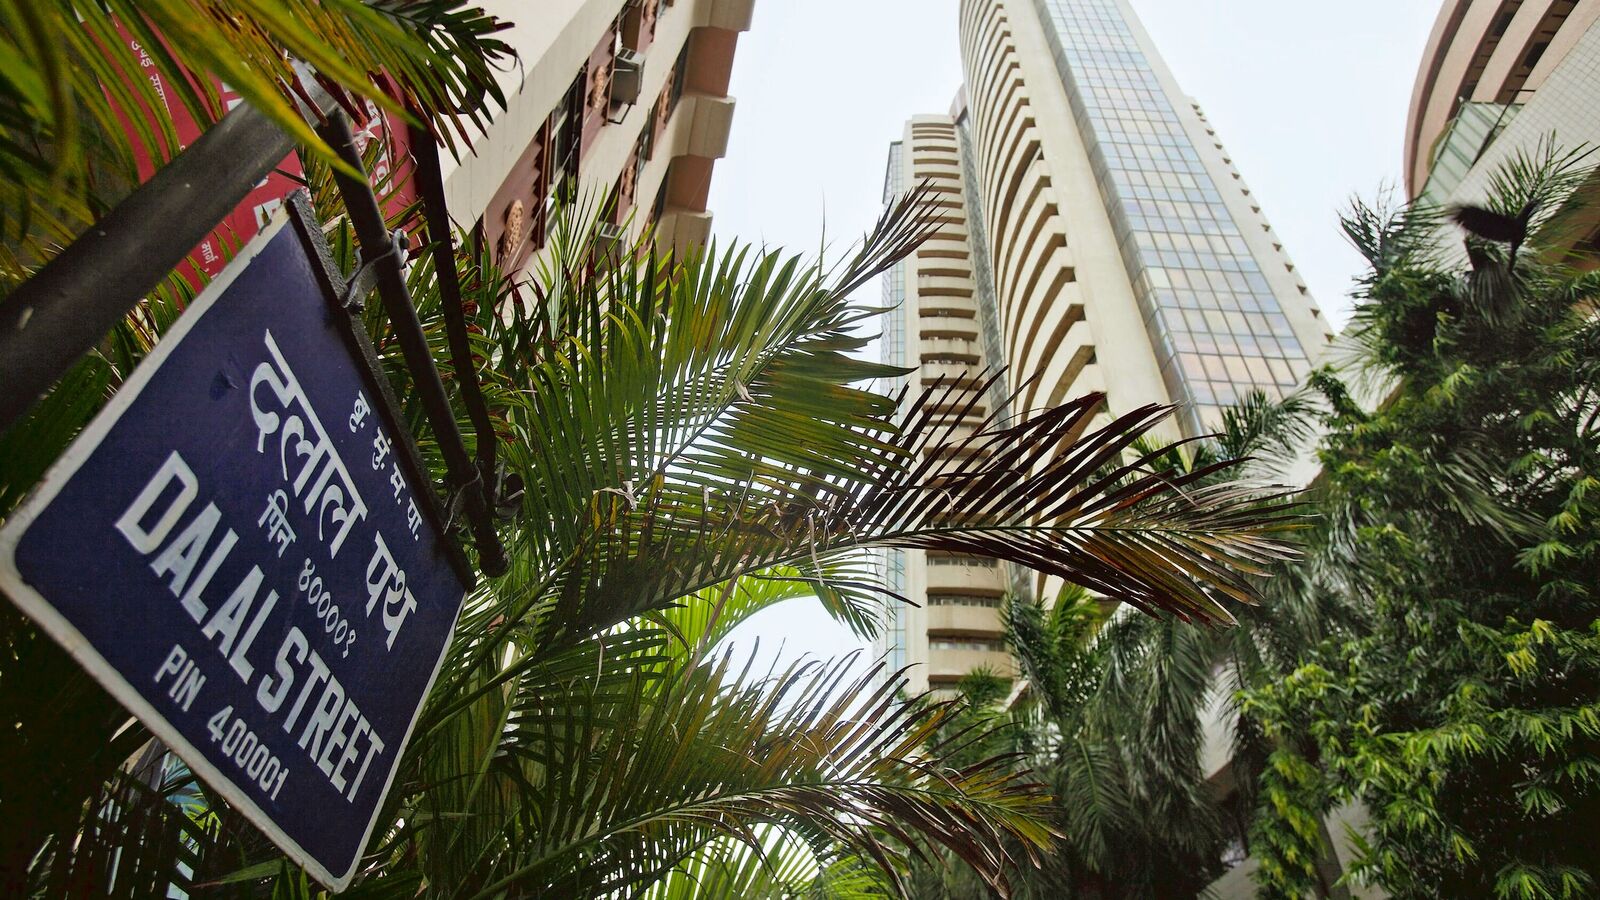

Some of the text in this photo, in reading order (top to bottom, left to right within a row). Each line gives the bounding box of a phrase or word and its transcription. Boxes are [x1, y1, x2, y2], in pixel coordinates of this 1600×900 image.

[249, 328, 418, 652] दलाल पथ
[257, 488, 357, 660] पिन ४००००१
[114, 450, 385, 804] DALAL STREET
[154, 644, 290, 801] PIN 400001
